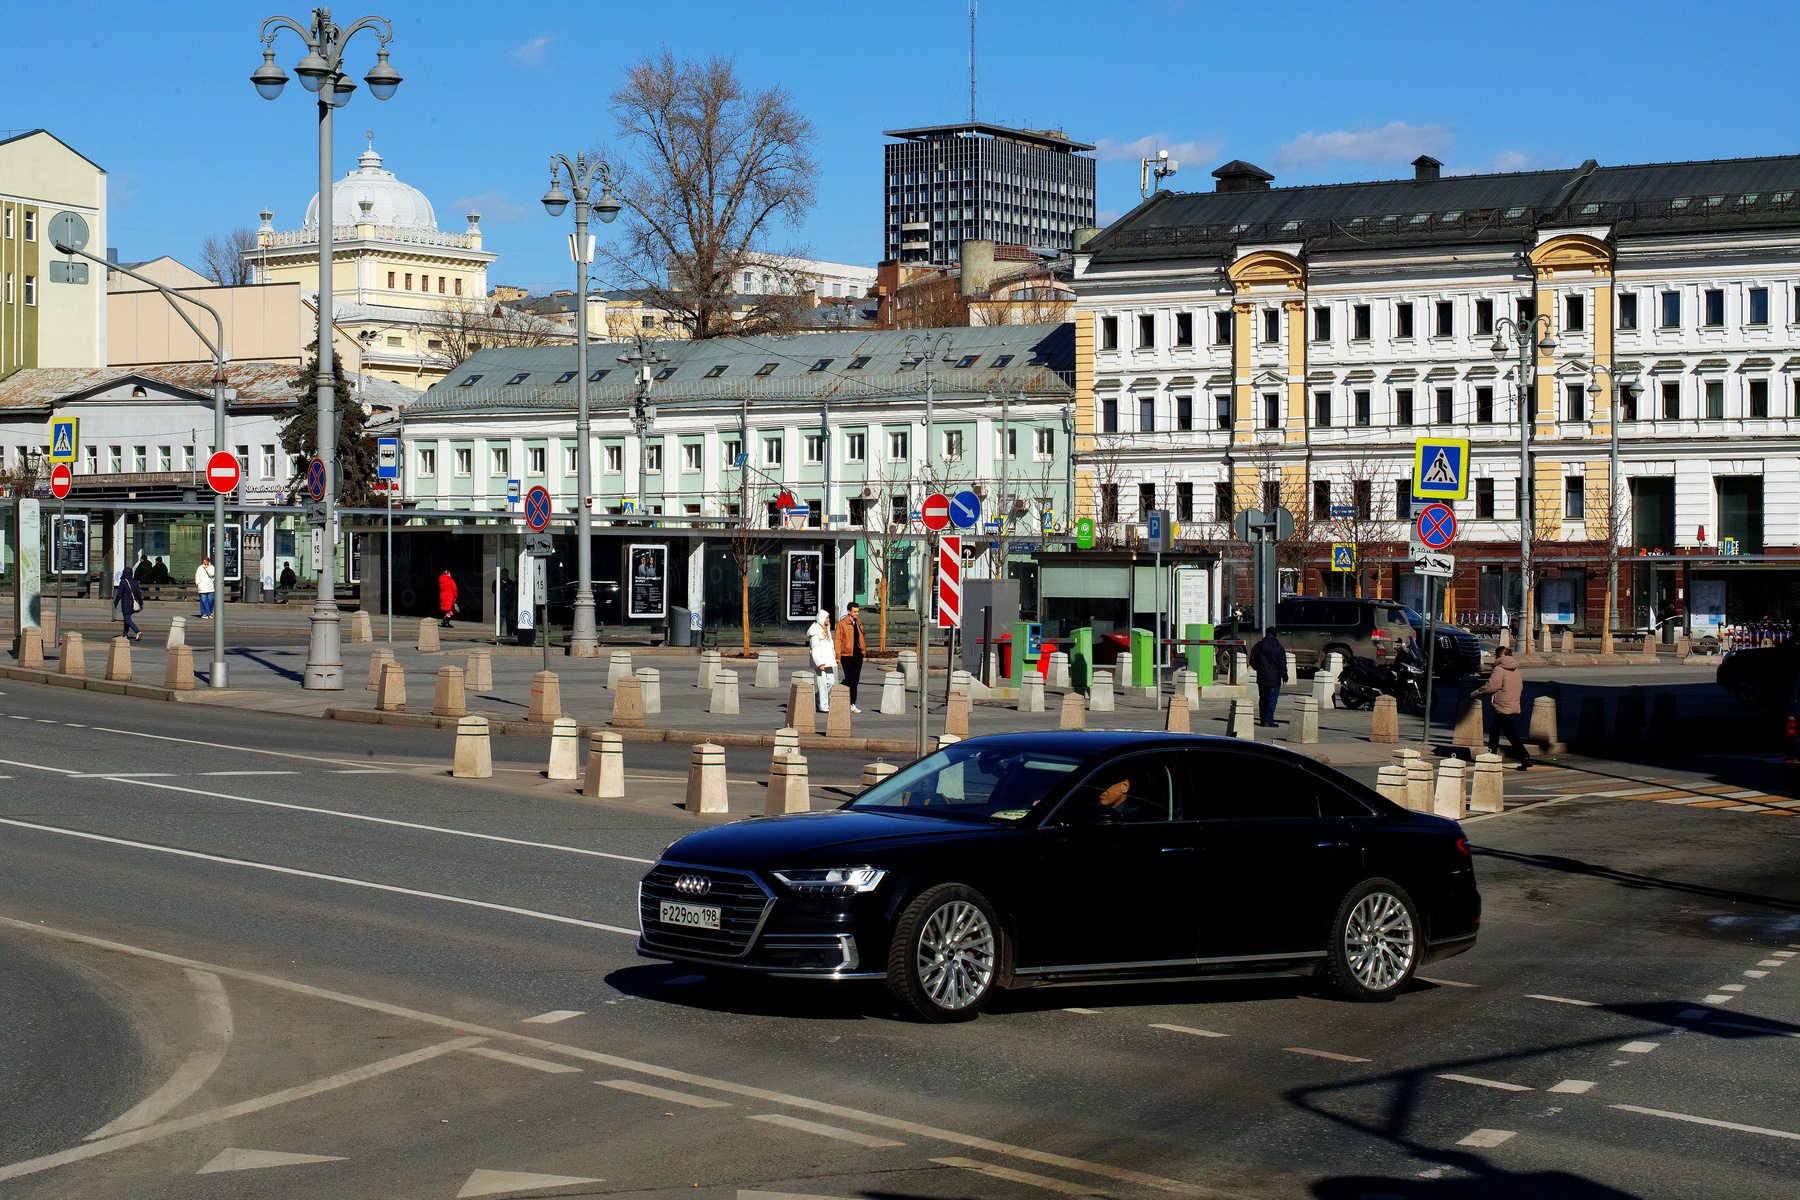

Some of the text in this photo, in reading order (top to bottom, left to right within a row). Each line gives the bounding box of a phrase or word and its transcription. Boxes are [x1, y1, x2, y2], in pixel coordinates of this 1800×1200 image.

[775, 491, 796, 509] М
[1151, 520, 1158, 536] P
[313, 545, 321, 554] 15
[536, 580, 544, 590] 15
[701, 908, 717, 922] 198
